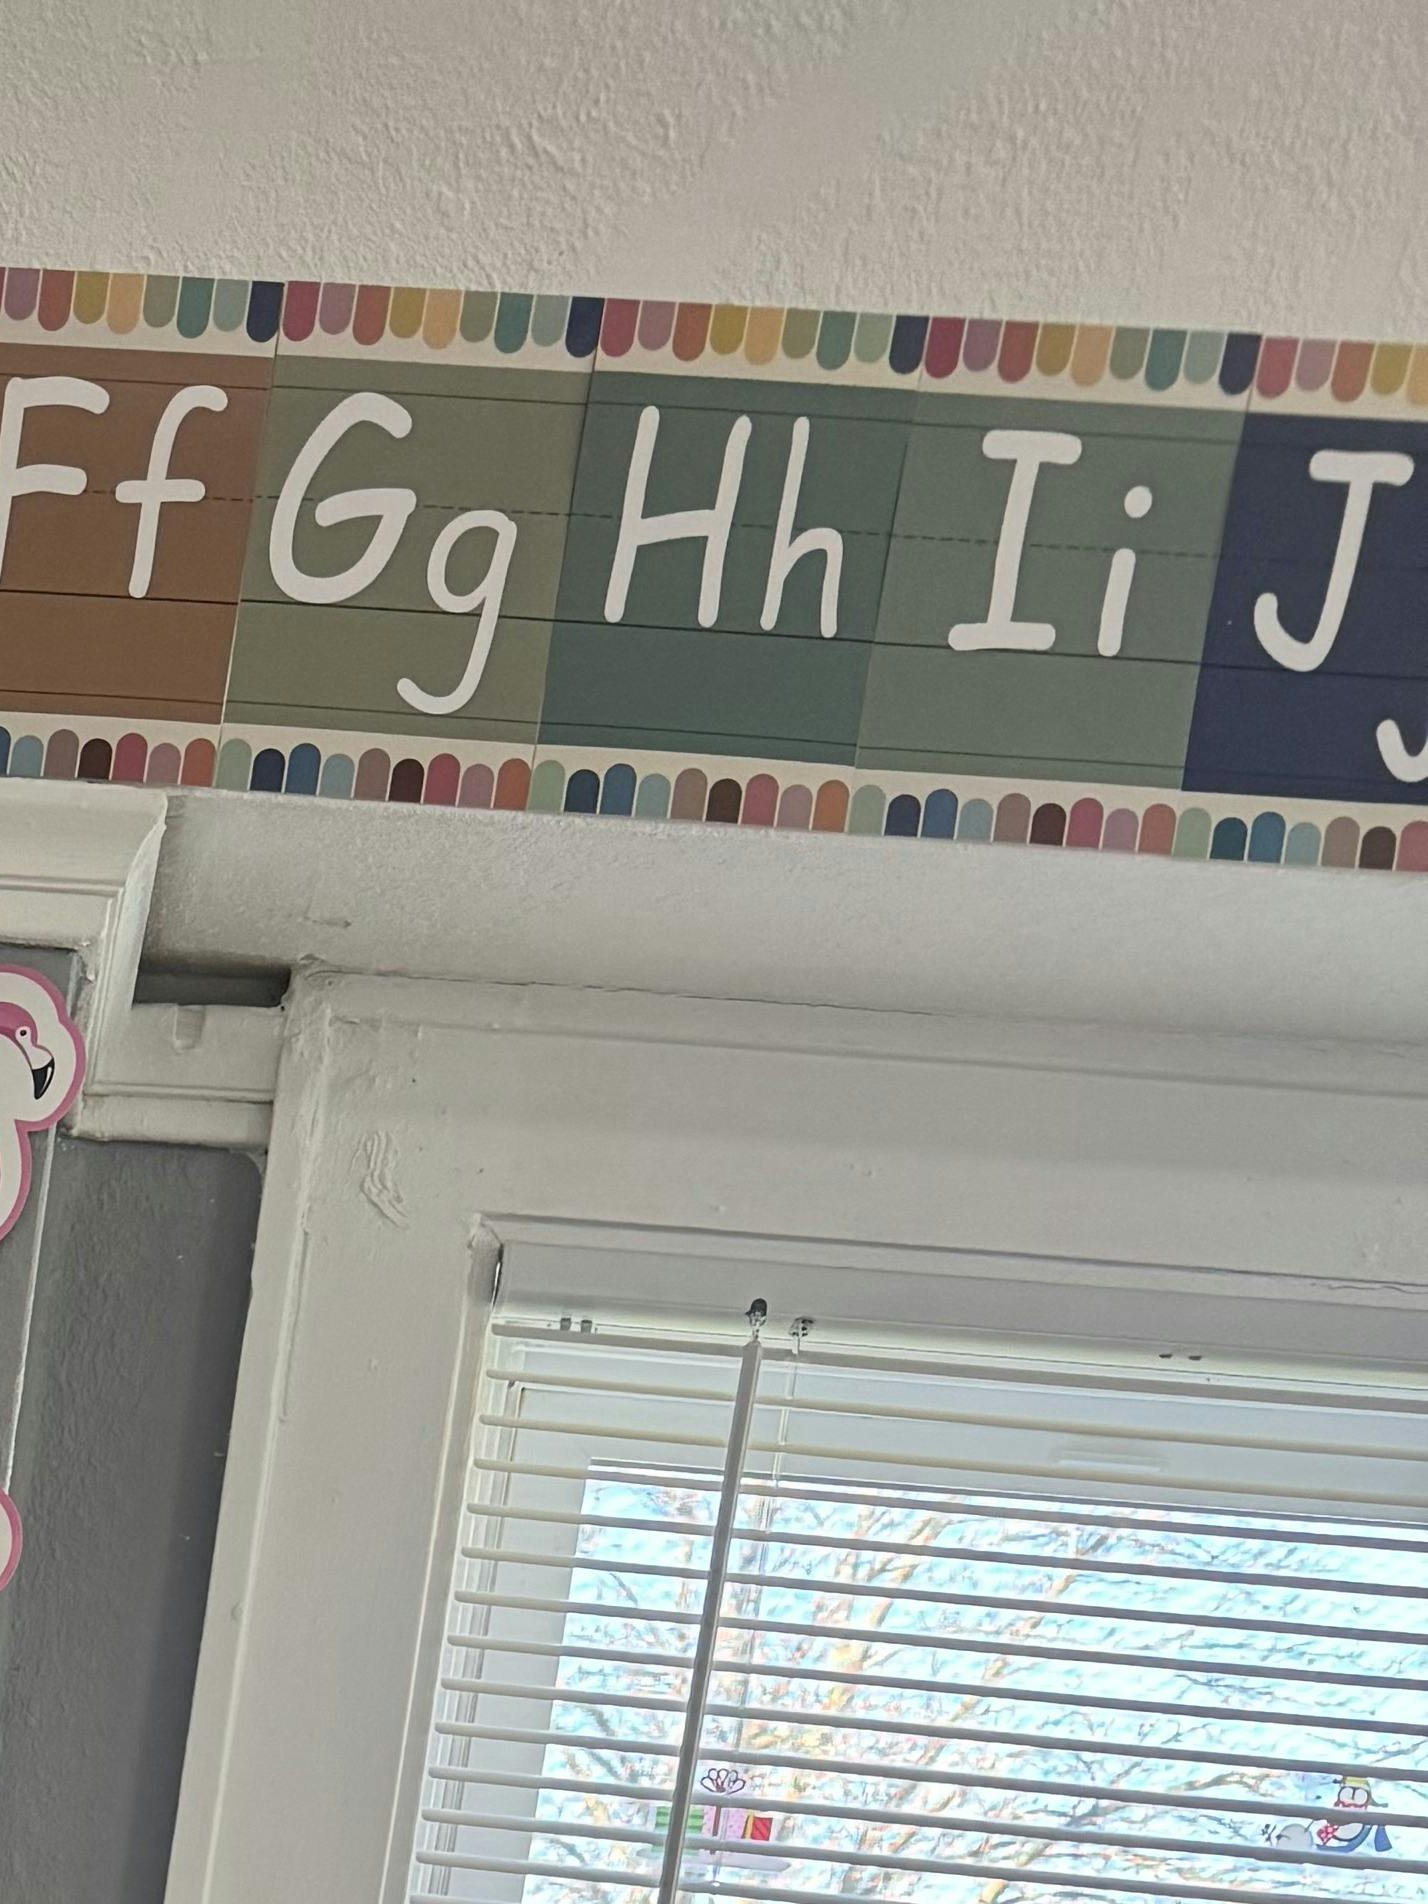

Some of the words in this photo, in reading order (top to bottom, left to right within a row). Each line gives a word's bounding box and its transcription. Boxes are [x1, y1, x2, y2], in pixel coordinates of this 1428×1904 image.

[268, 392, 519, 715] Gg
[602, 405, 844, 638] Hh
[948, 429, 1152, 658] Ii
[1252, 450, 1428, 783] J
